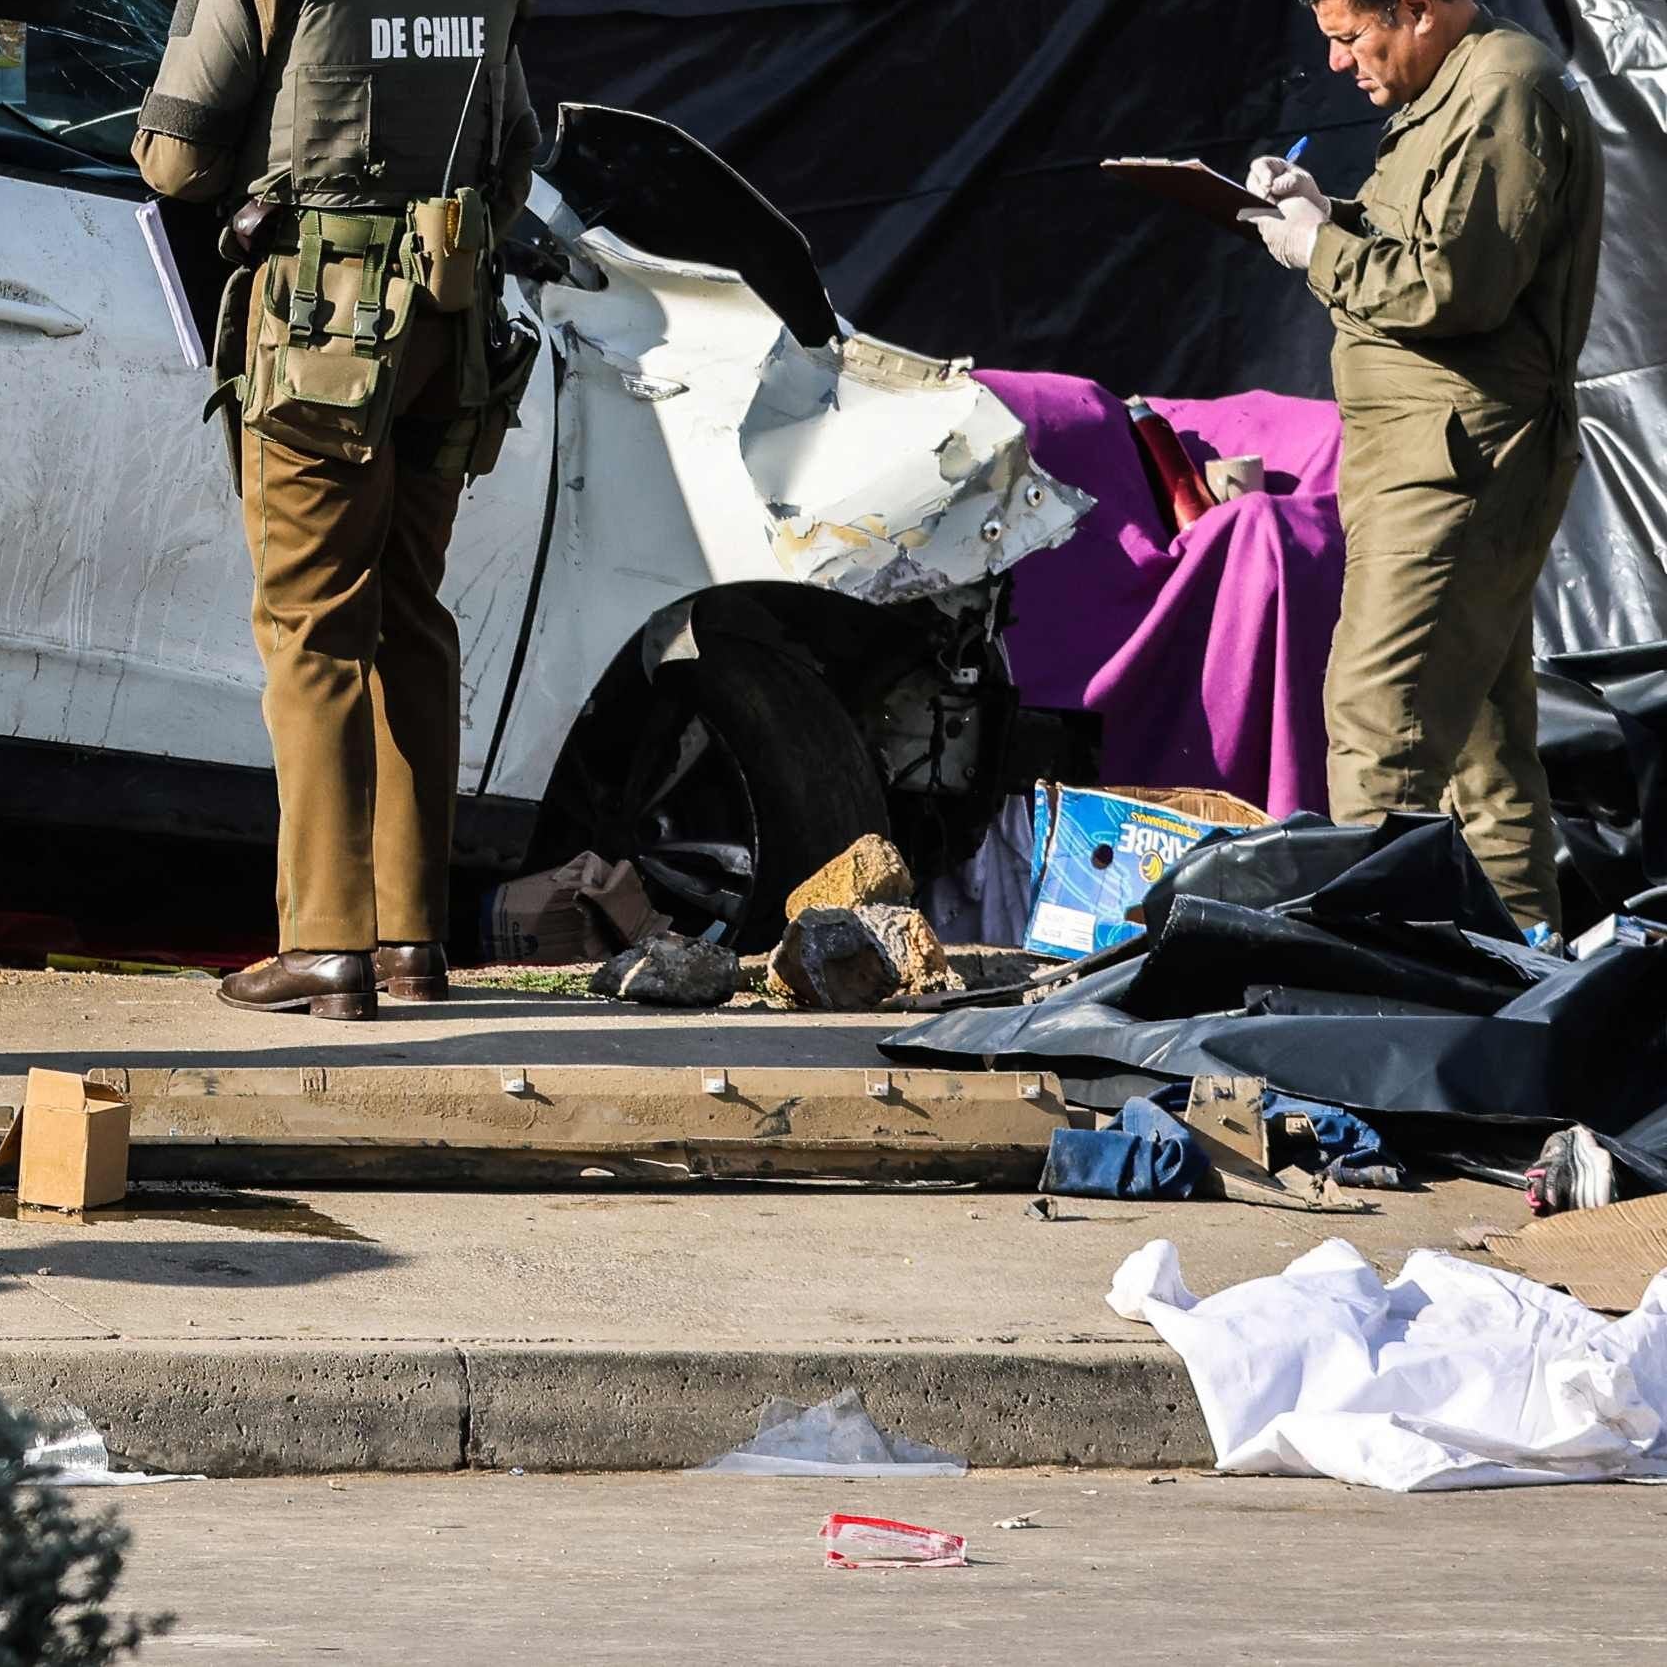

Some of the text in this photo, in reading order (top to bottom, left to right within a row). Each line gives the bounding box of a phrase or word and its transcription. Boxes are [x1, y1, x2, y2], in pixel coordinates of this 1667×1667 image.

[371, 16, 486, 59] DE CHILE
[1117, 823, 1196, 865] ARIBE
